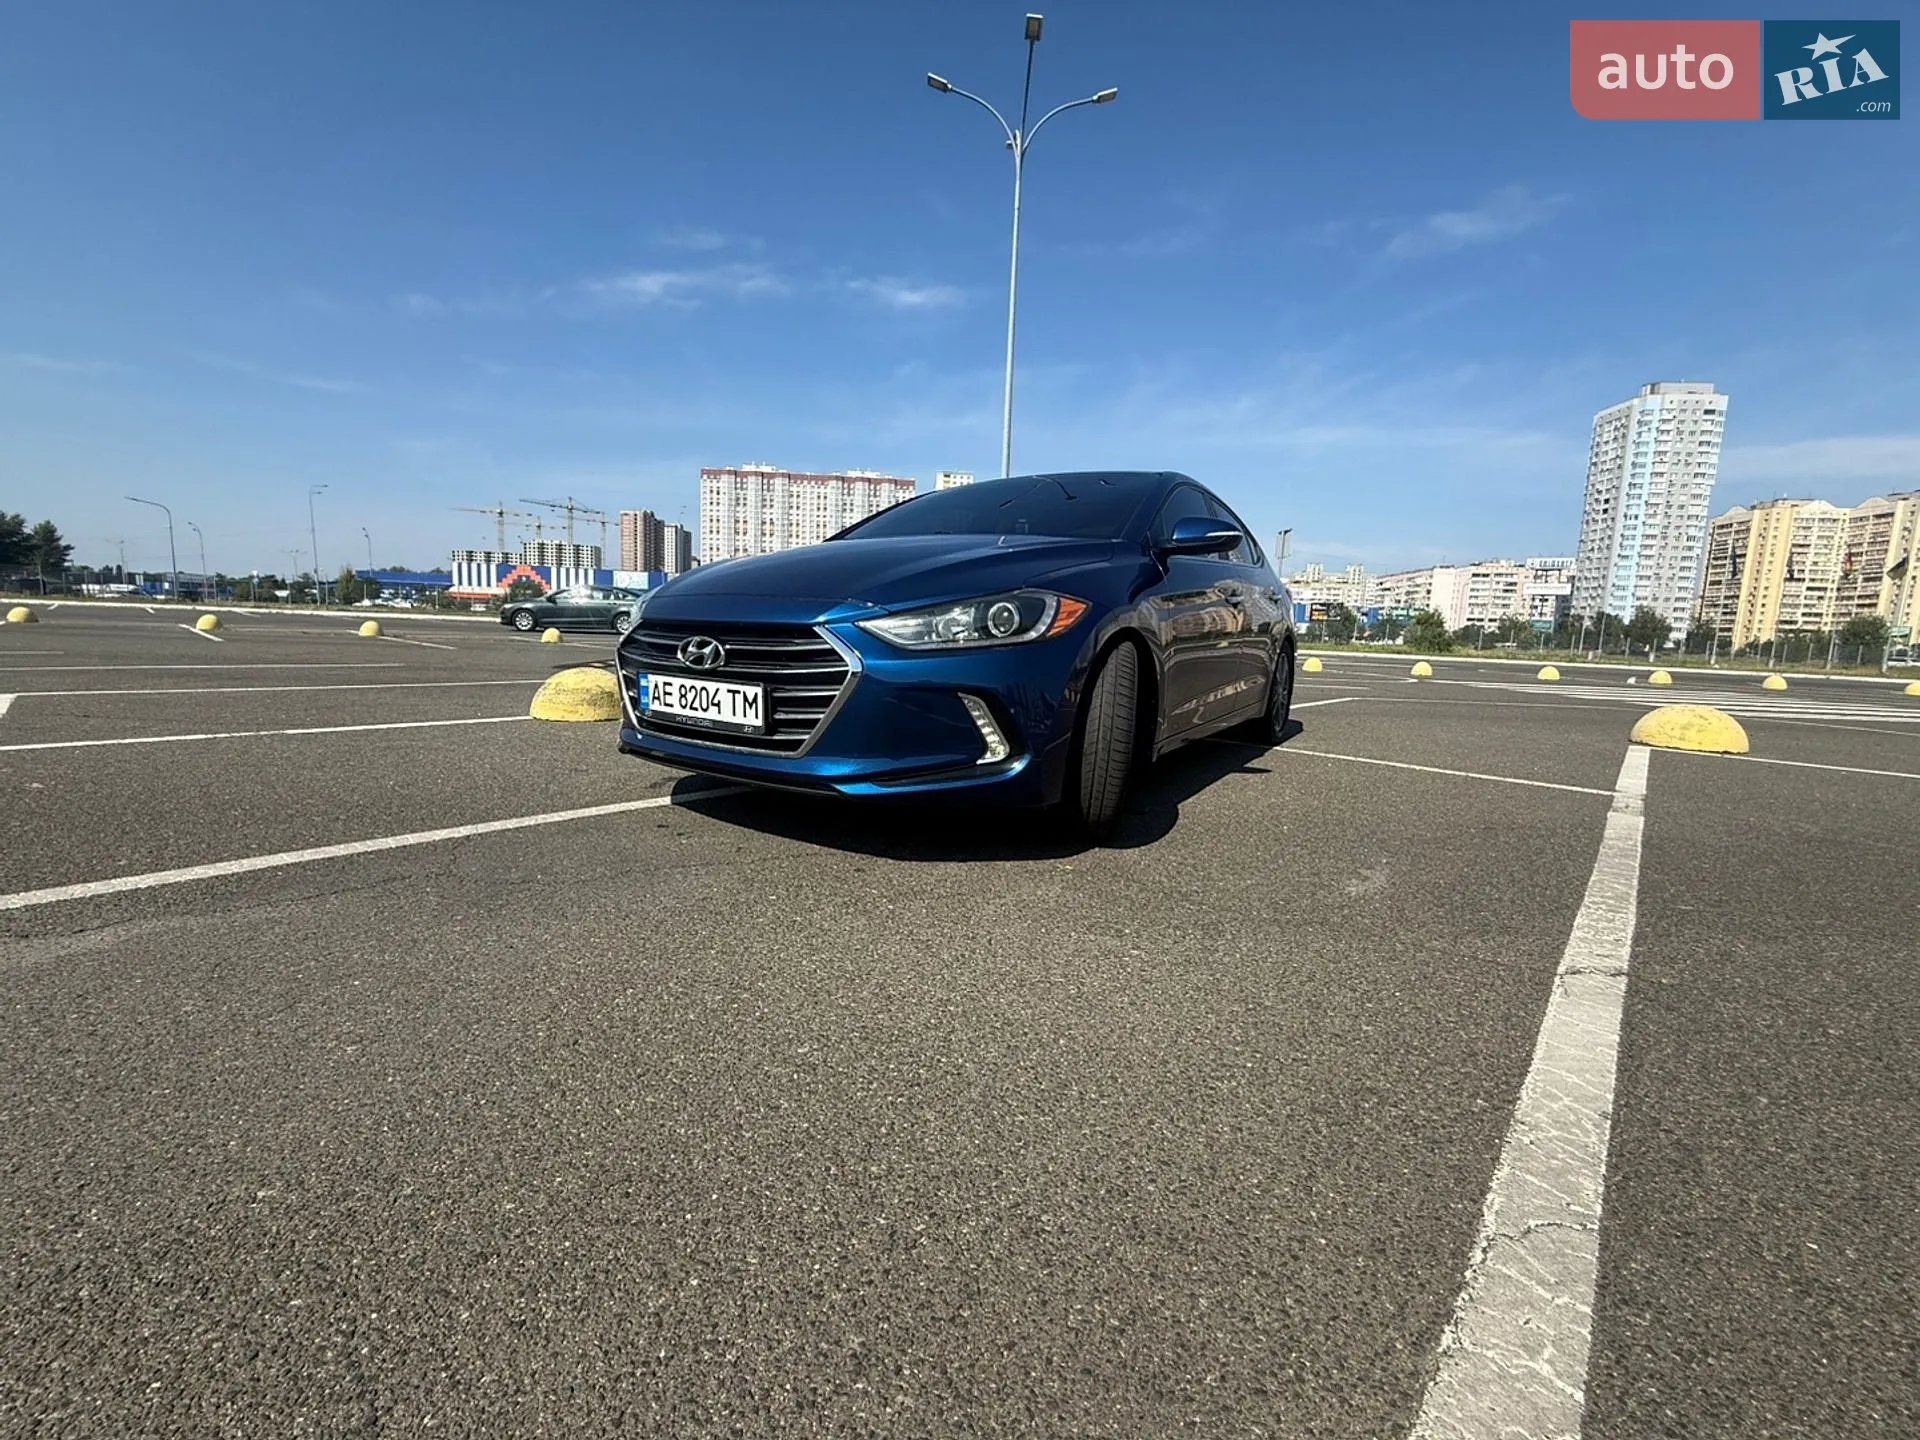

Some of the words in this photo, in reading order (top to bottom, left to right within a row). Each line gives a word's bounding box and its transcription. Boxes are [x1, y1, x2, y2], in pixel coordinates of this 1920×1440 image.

[651, 680, 674, 708] AE
[678, 684, 721, 714] 8204
[727, 688, 759, 719] TM
